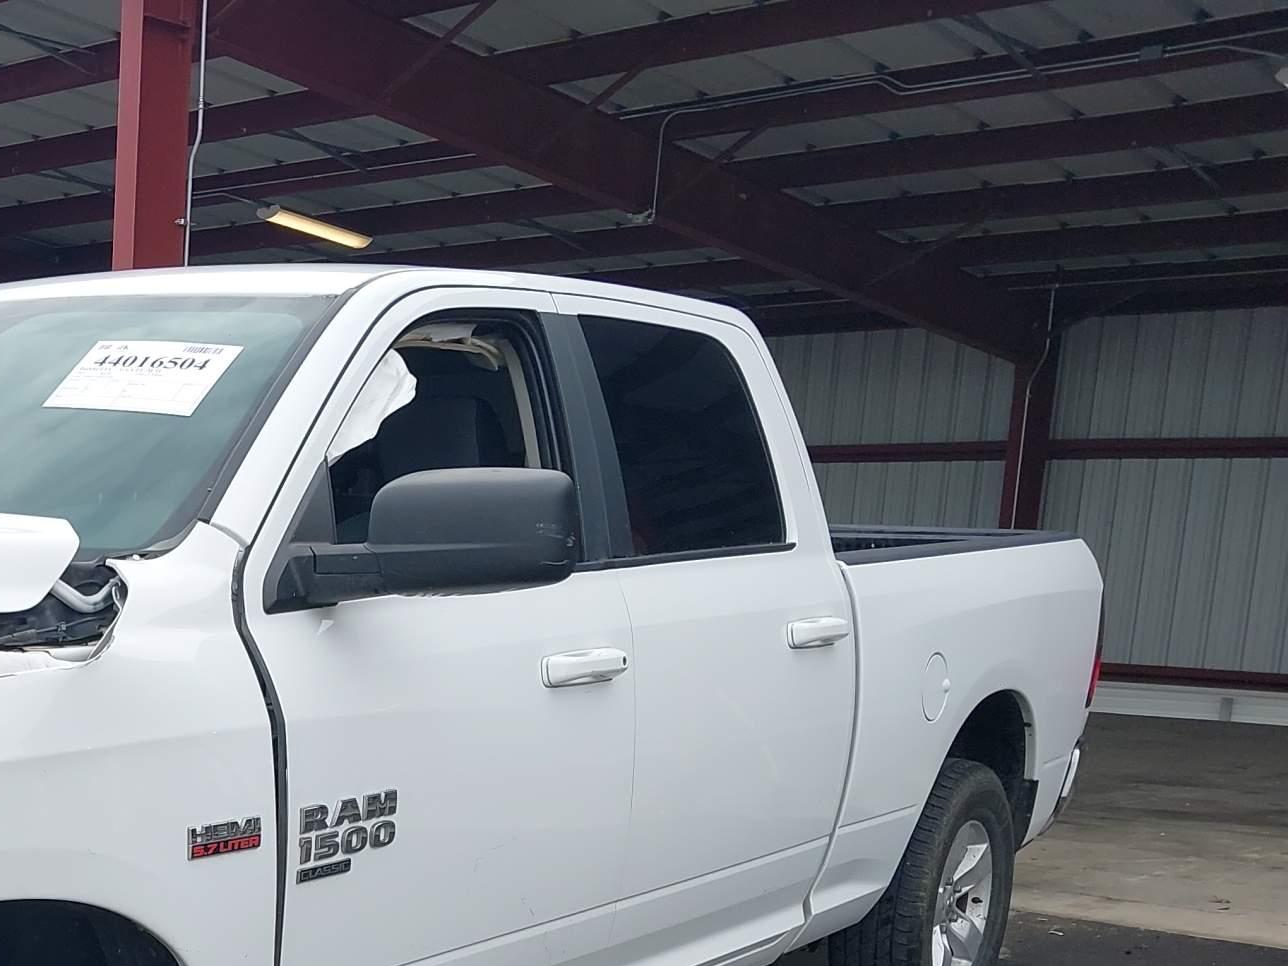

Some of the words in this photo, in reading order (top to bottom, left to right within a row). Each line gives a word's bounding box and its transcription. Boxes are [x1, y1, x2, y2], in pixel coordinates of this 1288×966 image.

[94, 354, 211, 371] 44016504
[299, 789, 398, 835] RAM
[187, 816, 261, 846] HEMI
[298, 820, 396, 865] 1500
[193, 843, 218, 858] 5.7
[219, 835, 260, 853] LITER
[300, 860, 351, 881] CLASSIC
